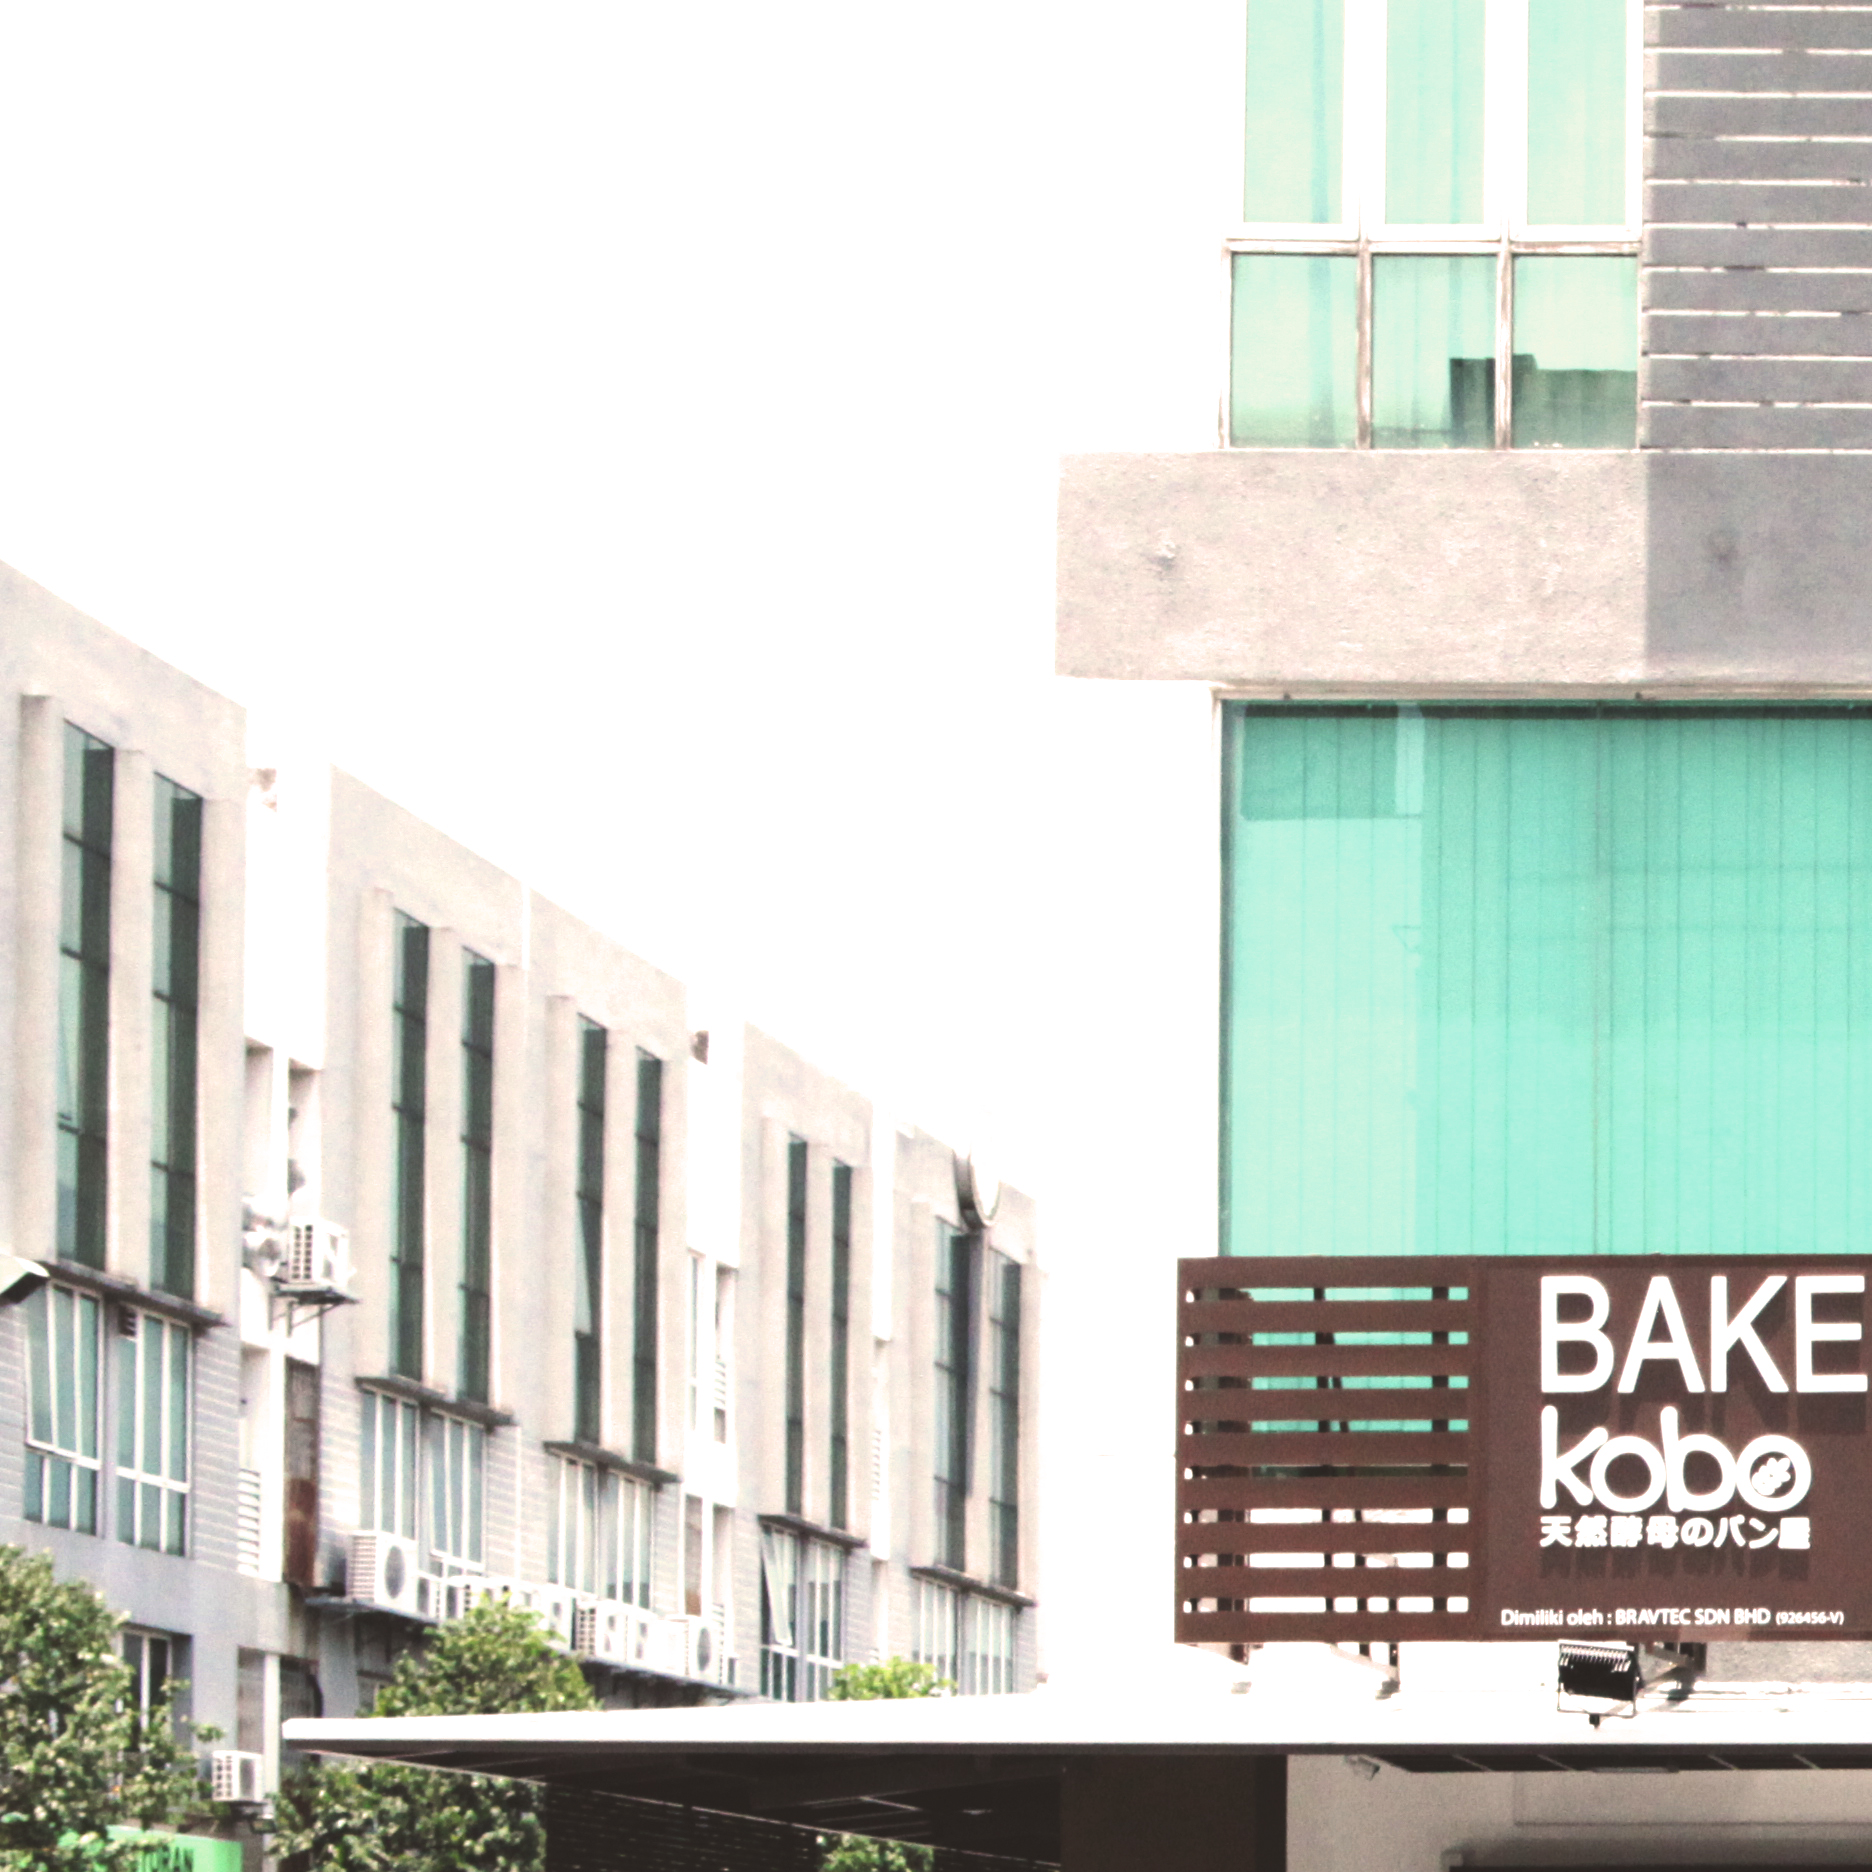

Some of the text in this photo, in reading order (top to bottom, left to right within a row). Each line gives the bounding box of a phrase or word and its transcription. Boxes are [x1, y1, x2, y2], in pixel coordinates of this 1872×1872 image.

[1540, 1404, 1812, 1513] kobo
[1539, 1514, 1811, 1551] 天然酵母のパン屋
[1500, 1608, 1564, 1627] Dimiliki
[1566, 1608, 1604, 1626] oleh
[1615, 1608, 1691, 1626] BRAVTEC
[1694, 1608, 1730, 1626] SDN
[1734, 1607, 1772, 1626] BHD
